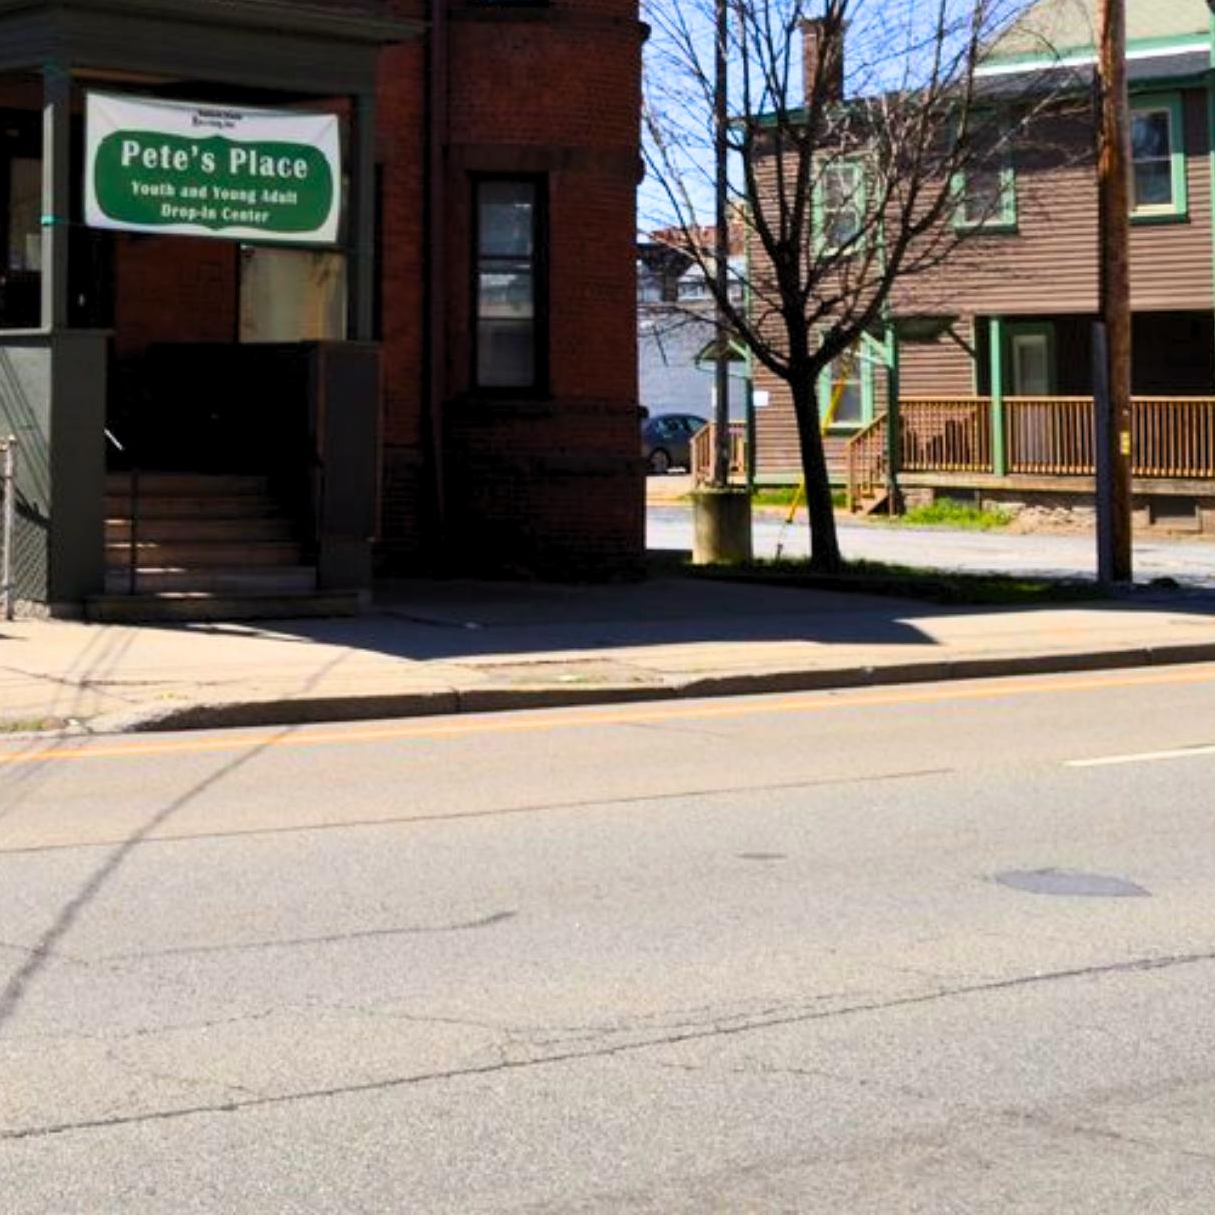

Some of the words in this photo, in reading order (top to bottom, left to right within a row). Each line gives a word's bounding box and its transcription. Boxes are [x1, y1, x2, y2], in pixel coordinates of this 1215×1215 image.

[121, 139, 215, 173] Pete's
[230, 148, 307, 178] Place
[131, 180, 176, 196] Youth
[180, 186, 208, 198] and
[212, 186, 256, 204] Young
[262, 188, 298, 205] Adult
[222, 207, 270, 223] Center
